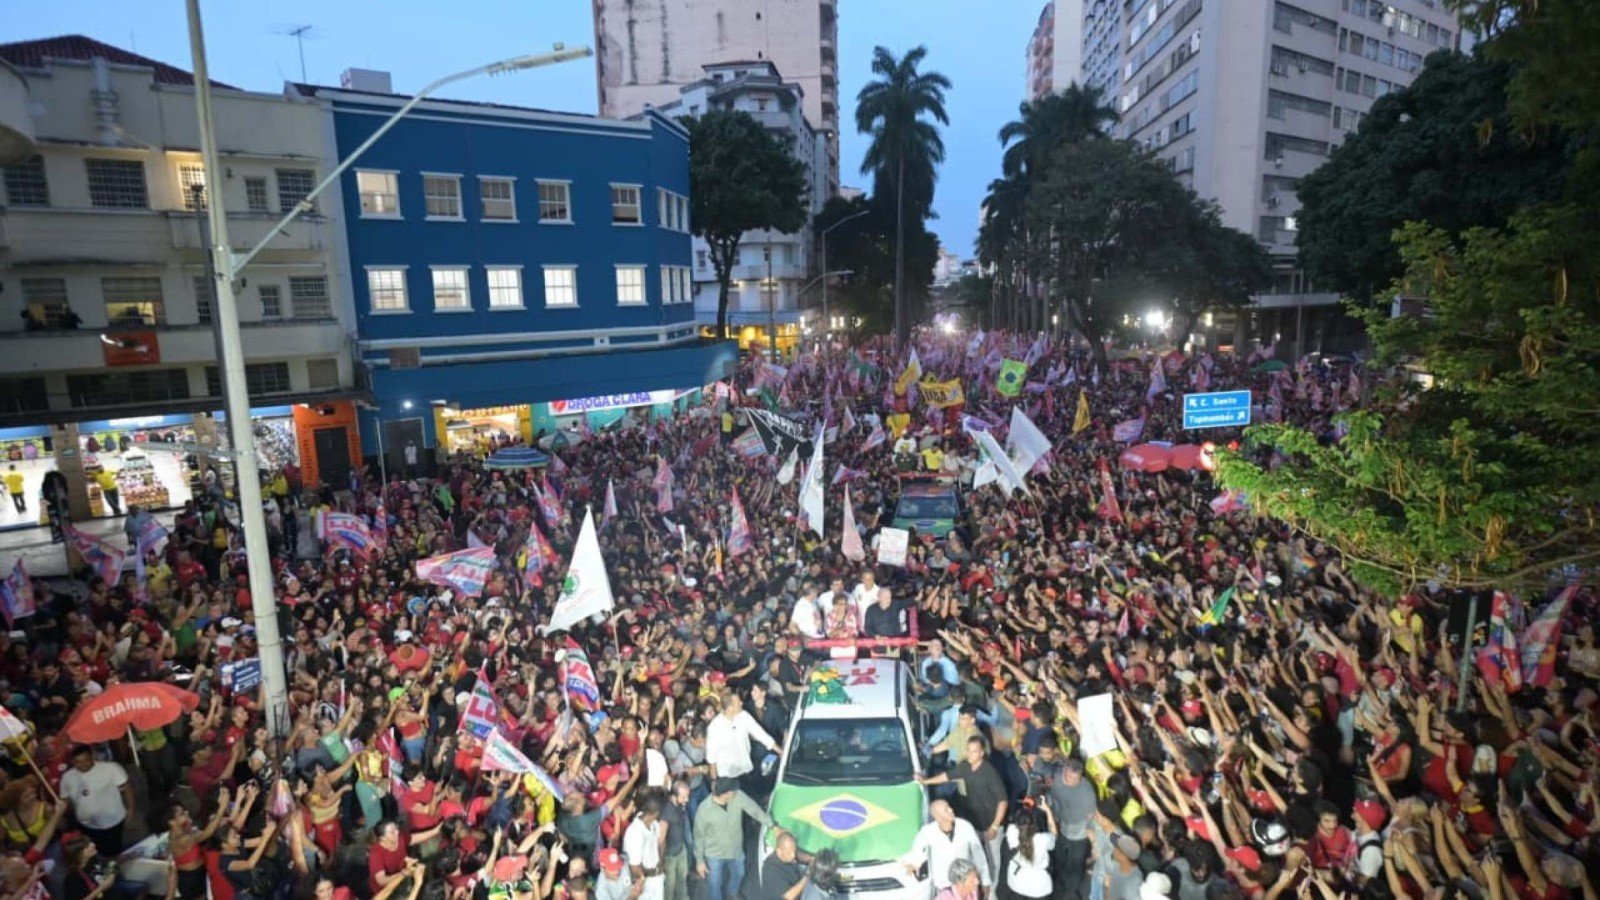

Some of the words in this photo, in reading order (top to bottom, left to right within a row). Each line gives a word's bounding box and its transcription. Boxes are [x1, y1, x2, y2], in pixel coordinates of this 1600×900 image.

[567, 396, 610, 410] DROGA
[613, 391, 652, 404] CLARA
[91, 695, 162, 725] BRAHMA
